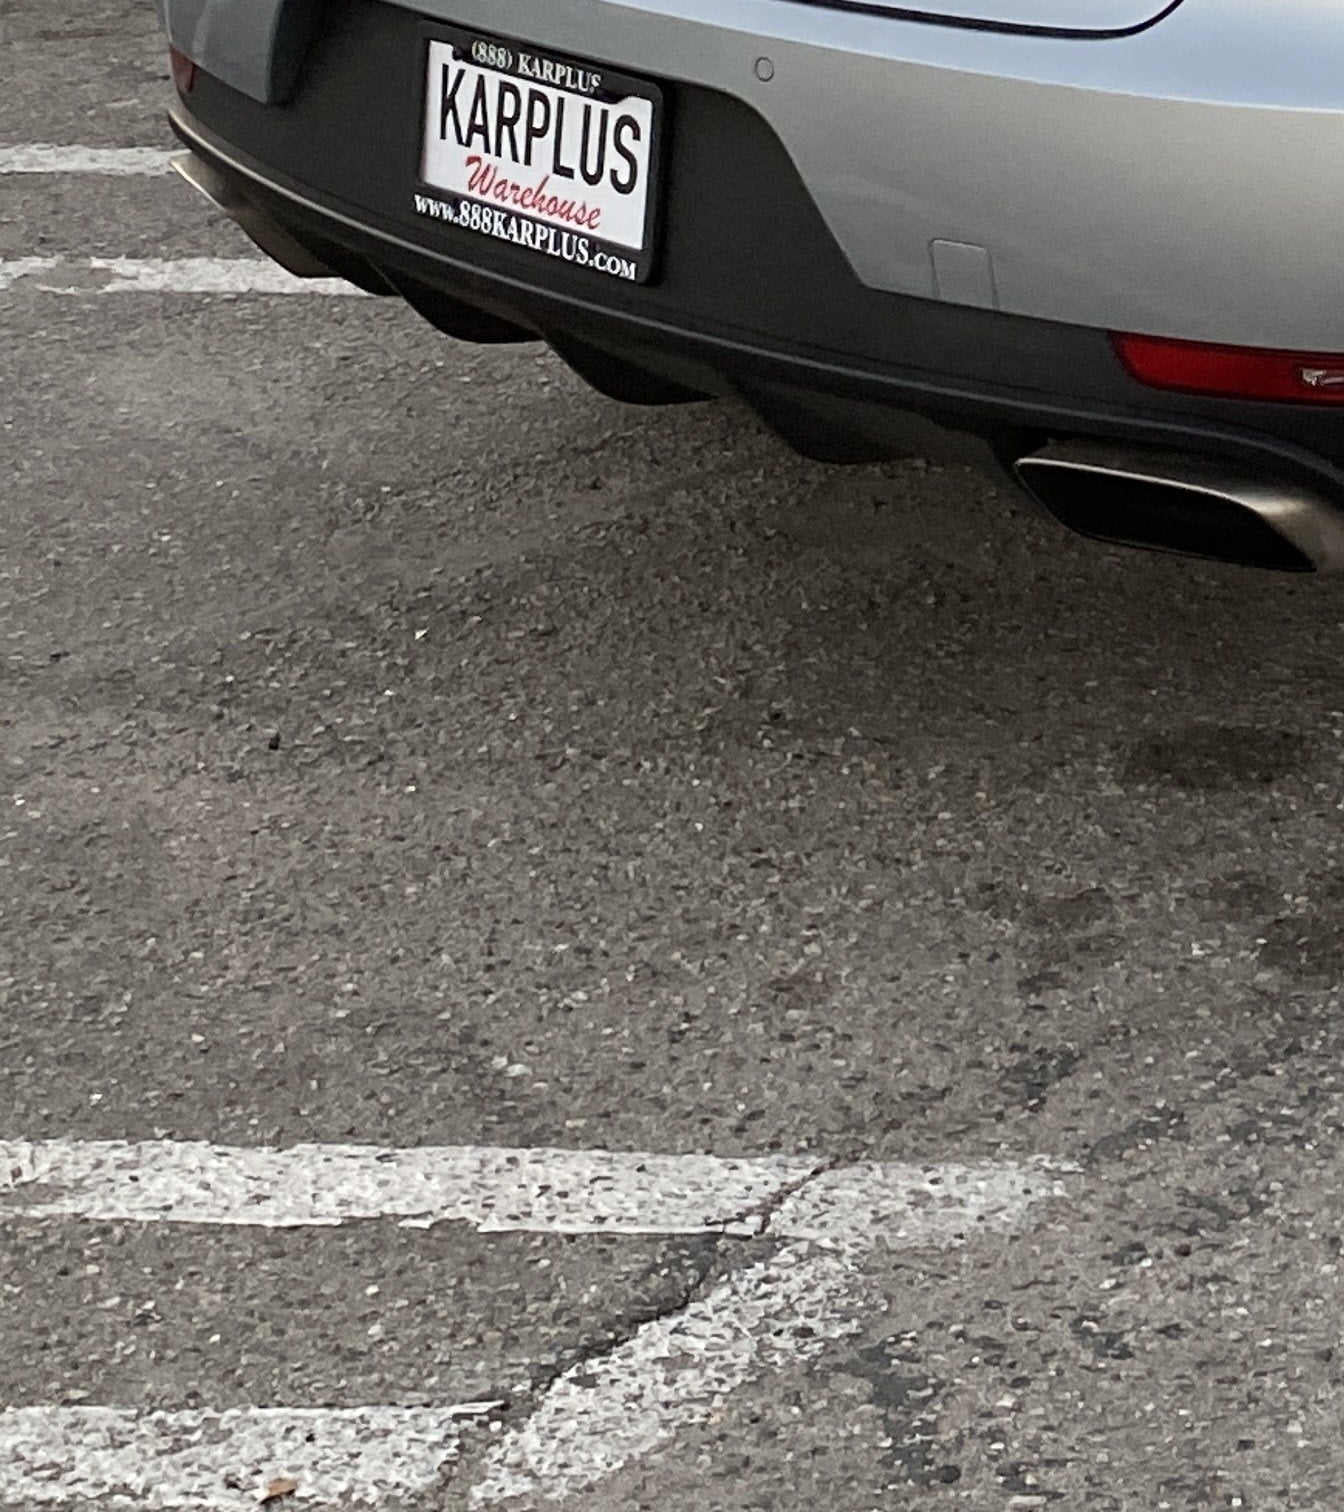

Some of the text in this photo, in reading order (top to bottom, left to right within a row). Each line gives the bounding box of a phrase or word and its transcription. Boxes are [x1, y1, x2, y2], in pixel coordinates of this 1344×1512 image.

[471, 40, 601, 94] (888) KARPLUS
[439, 63, 641, 195] KARPLUS
[465, 154, 602, 230] Warehouse
